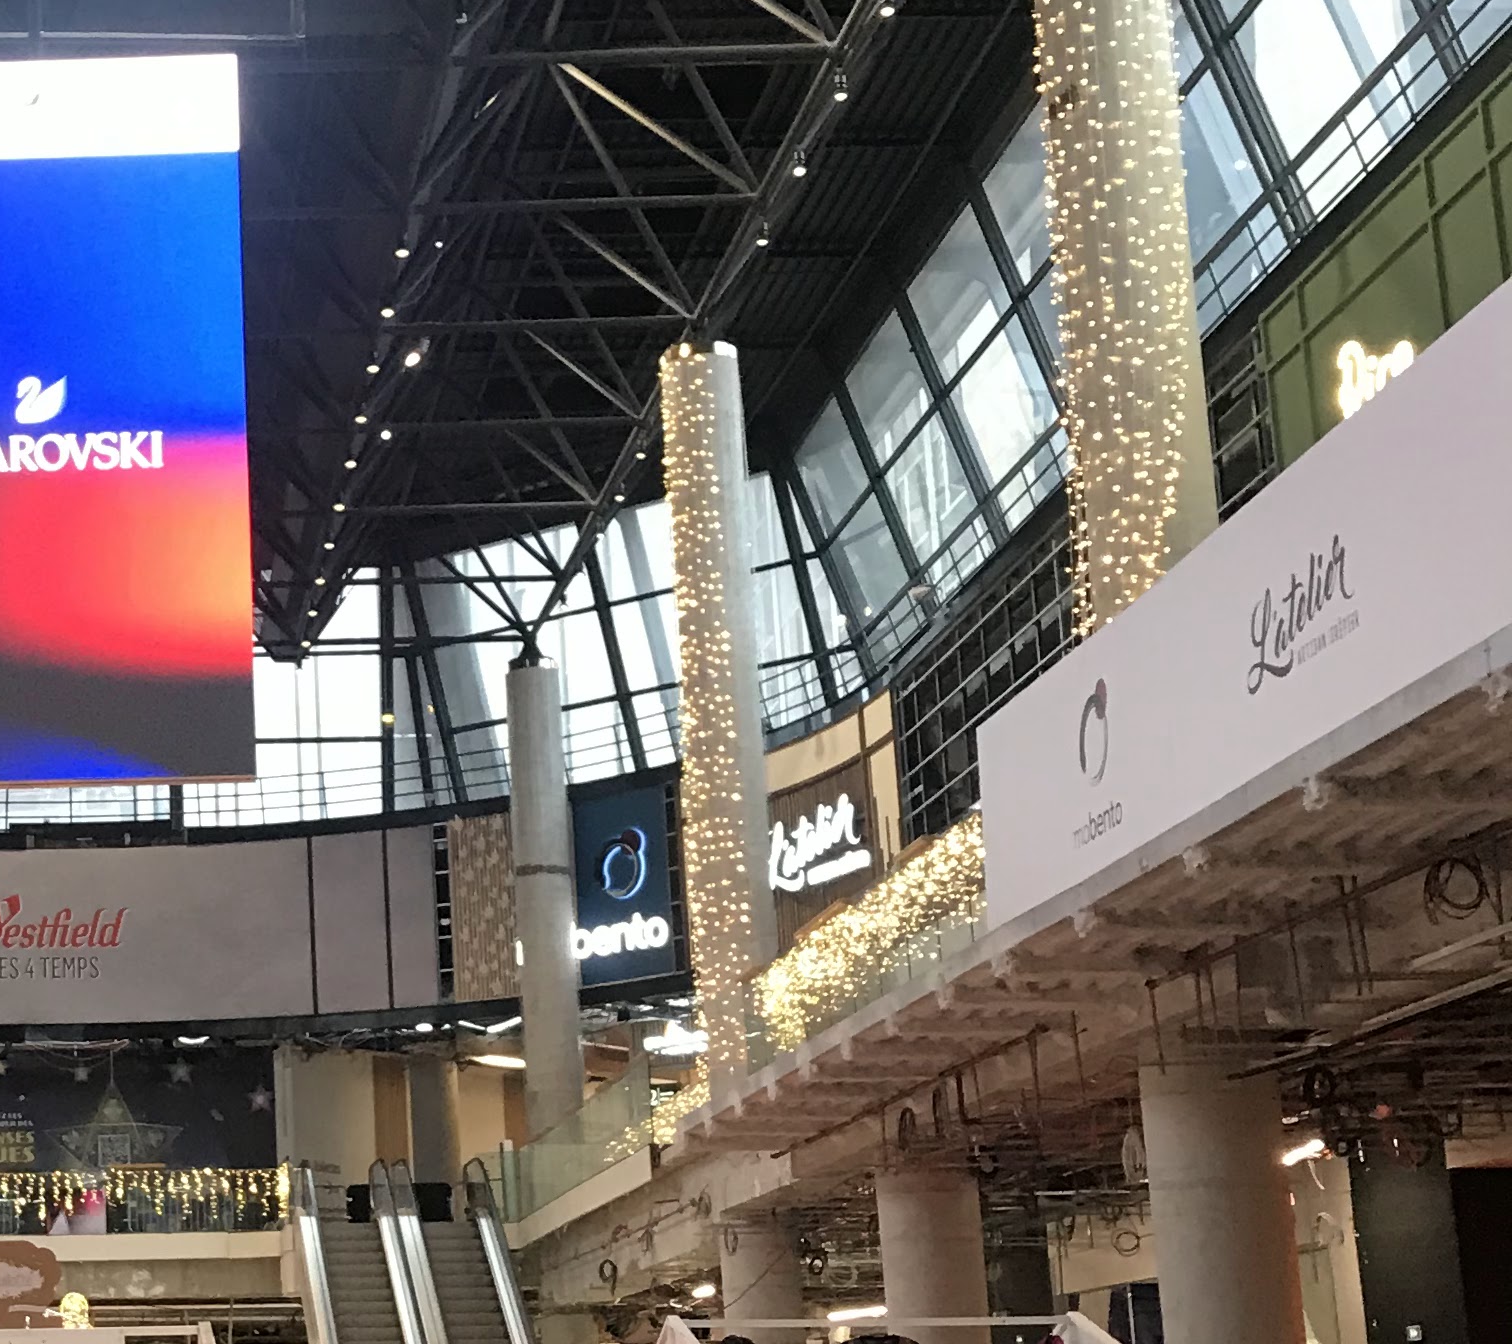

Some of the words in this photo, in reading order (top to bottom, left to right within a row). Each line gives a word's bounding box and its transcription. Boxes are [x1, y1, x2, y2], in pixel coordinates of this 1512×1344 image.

[570, 912, 669, 959] bento
[24, 957, 34, 979] 4
[40, 956, 100, 979] TEMPS
